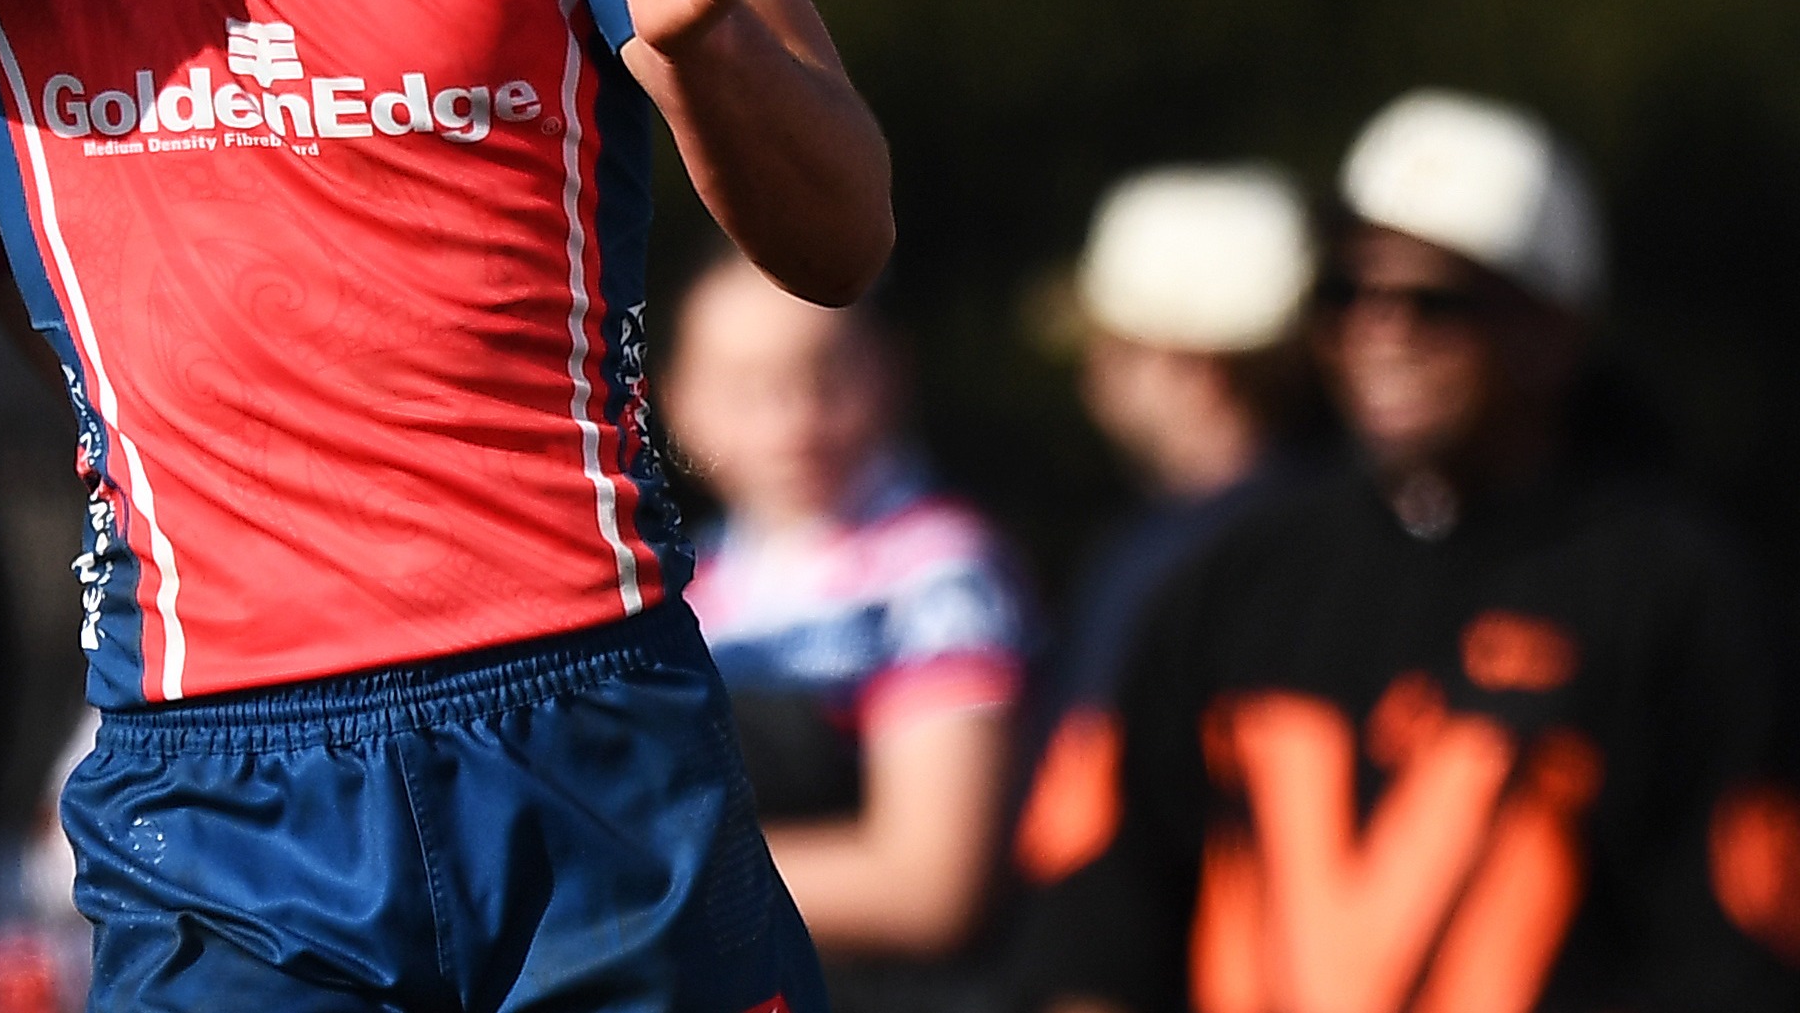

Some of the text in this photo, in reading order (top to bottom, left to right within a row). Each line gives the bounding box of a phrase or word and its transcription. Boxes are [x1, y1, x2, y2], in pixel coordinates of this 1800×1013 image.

[42, 67, 542, 143] GoldenEdge
[83, 132, 321, 157] Medium Density Fibrebard
